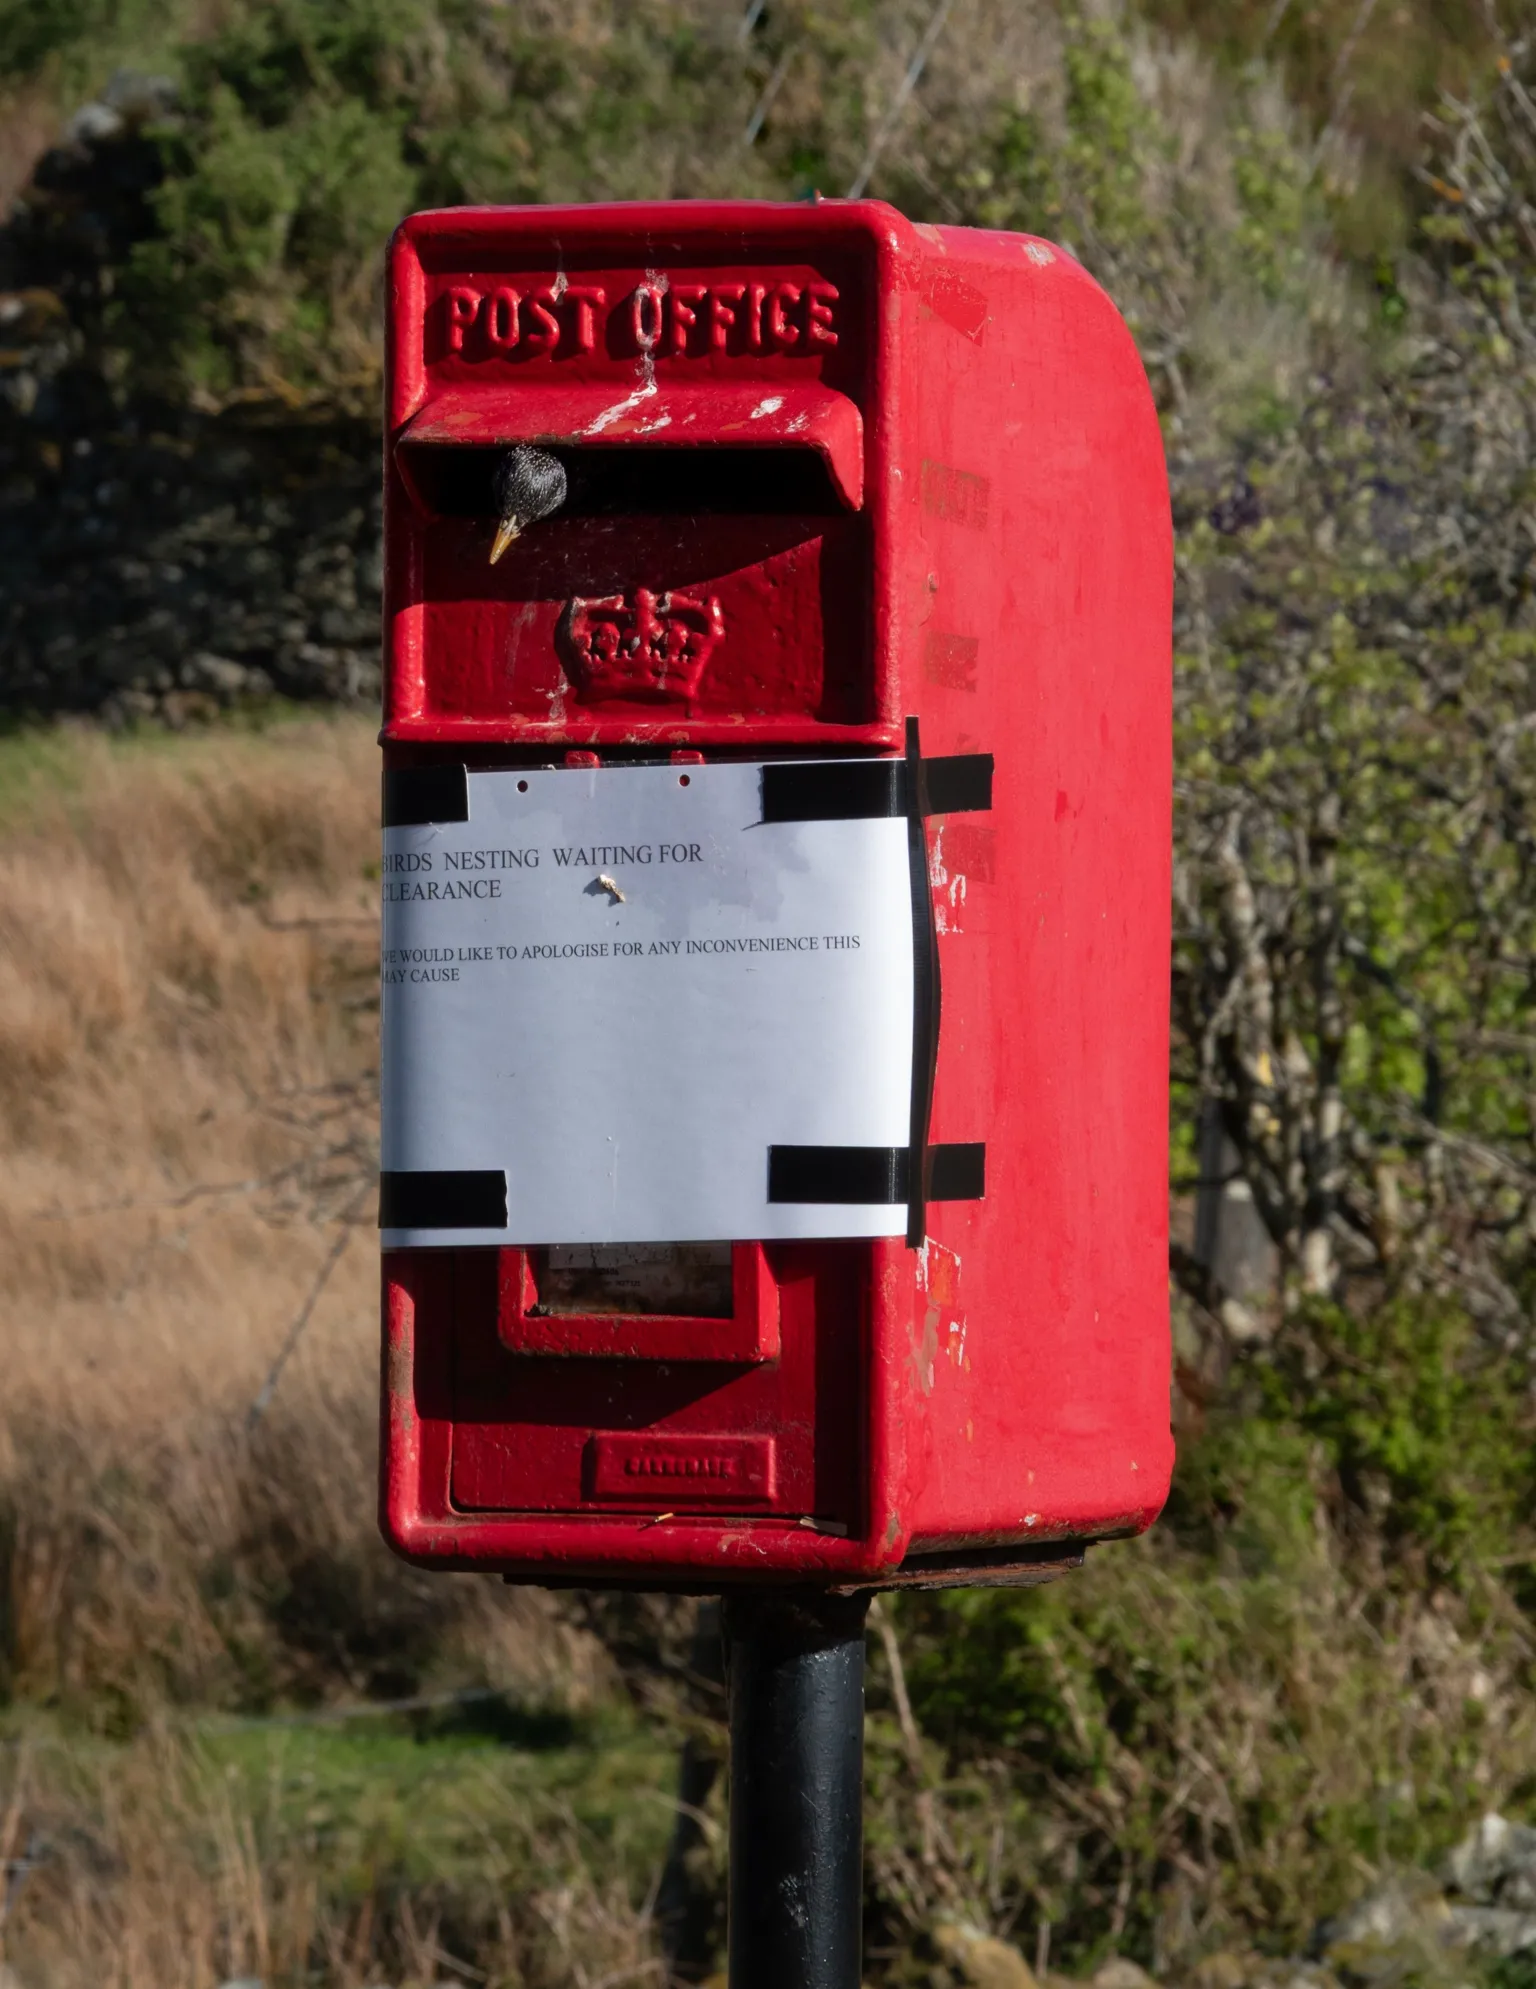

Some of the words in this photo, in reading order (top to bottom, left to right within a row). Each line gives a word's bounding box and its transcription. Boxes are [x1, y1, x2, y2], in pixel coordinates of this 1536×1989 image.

[448, 285, 606, 352] POST
[633, 282, 840, 351] OFFICE
[444, 848, 540, 871] NESTING
[552, 845, 653, 868] WAITING
[659, 843, 705, 863] FOR
[382, 879, 502, 903] CLEARANCE
[400, 948, 454, 963] WOULD
[458, 947, 493, 962] LIKE
[496, 946, 517, 960] TO
[521, 943, 610, 959] APOLOGISE
[613, 942, 644, 956] FOR
[648, 940, 681, 955] ANY
[686, 936, 819, 954] INCONVENIENCE
[823, 935, 861, 949] THIS
[410, 968, 460, 983] CAUSE
